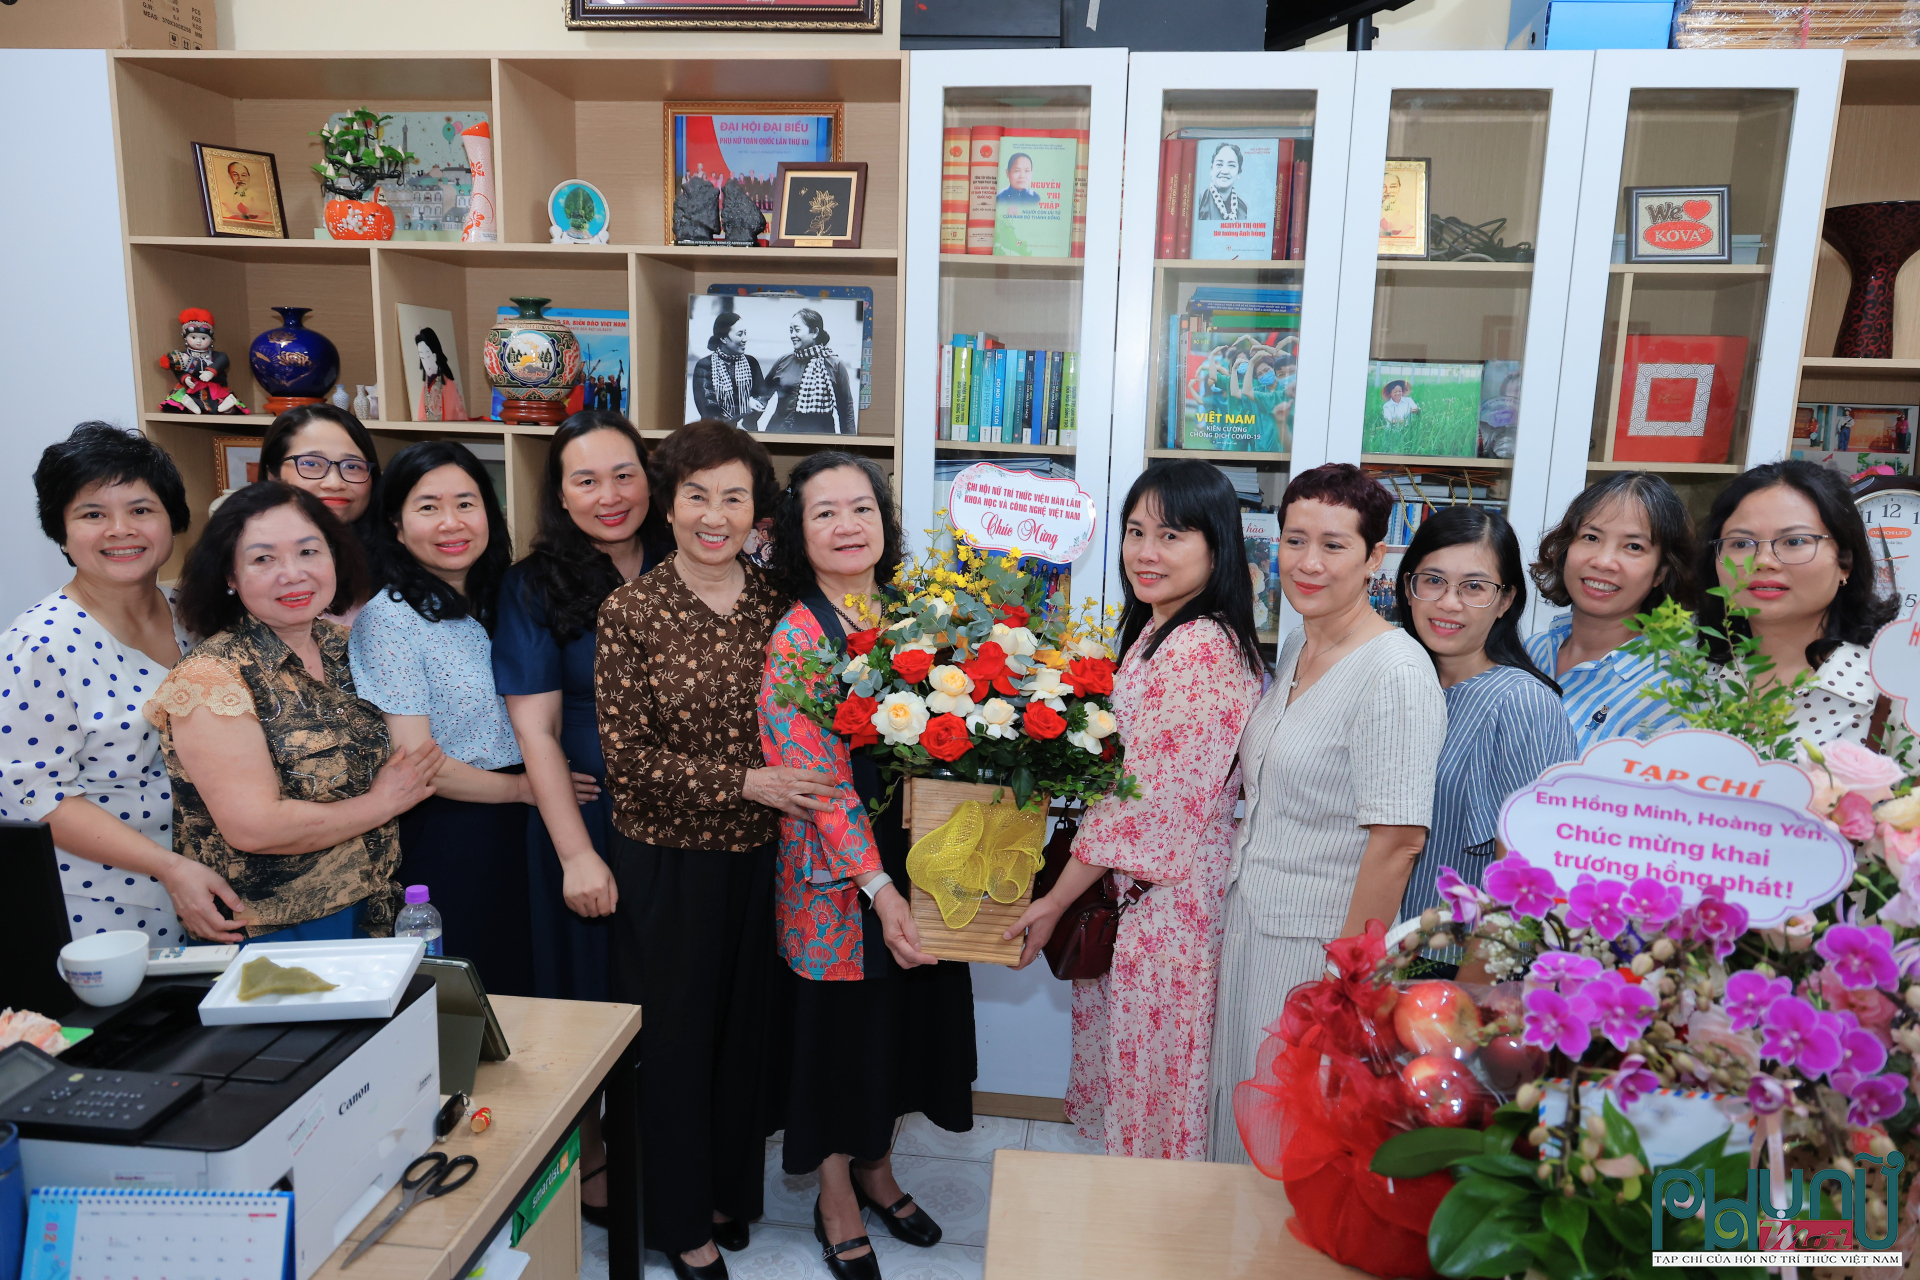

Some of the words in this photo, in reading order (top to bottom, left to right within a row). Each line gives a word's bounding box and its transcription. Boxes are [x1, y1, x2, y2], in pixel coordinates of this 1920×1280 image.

[720, 122, 739, 134] ĐẠI
[742, 121, 761, 134] HỘI
[763, 122, 782, 134] ĐẠI
[784, 120, 809, 132] BIỂU
[720, 137, 732, 146] PHỤ
[733, 136, 742, 144] NỮ
[759, 136, 775, 145] QUỐC
[1031, 179, 1061, 189] NGUYỄN
[1047, 192, 1061, 201] THỊ
[1038, 201, 1060, 211] THẬP
[1646, 202, 1683, 224] We
[1654, 229, 1702, 242] KOVA
[1196, 410, 1222, 425] VIỆT
[1225, 414, 1256, 424] NAM
[1190, 430, 1213, 438] CHỐNG
[967, 482, 979, 492] CHI
[979, 484, 990, 494] HỘI
[992, 485, 1002, 496] NỮ
[1003, 486, 1015, 498] TRÍ
[1015, 488, 1032, 501] THỨC
[1033, 493, 1049, 504] VIỆN
[1051, 494, 1065, 506] HÀN
[1066, 497, 1081, 508] LÂM
[964, 494, 981, 505] KHOA
[983, 497, 997, 509] HỌC
[999, 498, 1008, 509] VÀ
[1009, 500, 1028, 512] CÔNG
[1029, 504, 1047, 516] NGHỆ
[1048, 506, 1063, 518] VIỆT
[1065, 510, 1081, 521] NAM
[1881, 503, 1901, 518] 12
[981, 511, 1013, 540] Chúc
[1017, 518, 1059, 550] Mừng
[1246, 523, 1266, 533] hào
[1905, 593, 1917, 608] 5
[1622, 758, 1690, 783] TẠP
[1697, 775, 1766, 797] CHÍ
[1536, 791, 1567, 808] Em
[1572, 795, 1628, 818] Hồng
[1634, 804, 1692, 827] Minh,
[1698, 812, 1772, 837] Hoàng
[1556, 822, 1622, 847] Chúc
[1628, 834, 1705, 861] mừng
[1711, 842, 1771, 867] khai
[1554, 850, 1639, 881] trương
[1646, 860, 1713, 887] hồng
[1720, 874, 1794, 899] phát!
[338, 1082, 370, 1116] Canon
[532, 1163, 560, 1209] smartist
